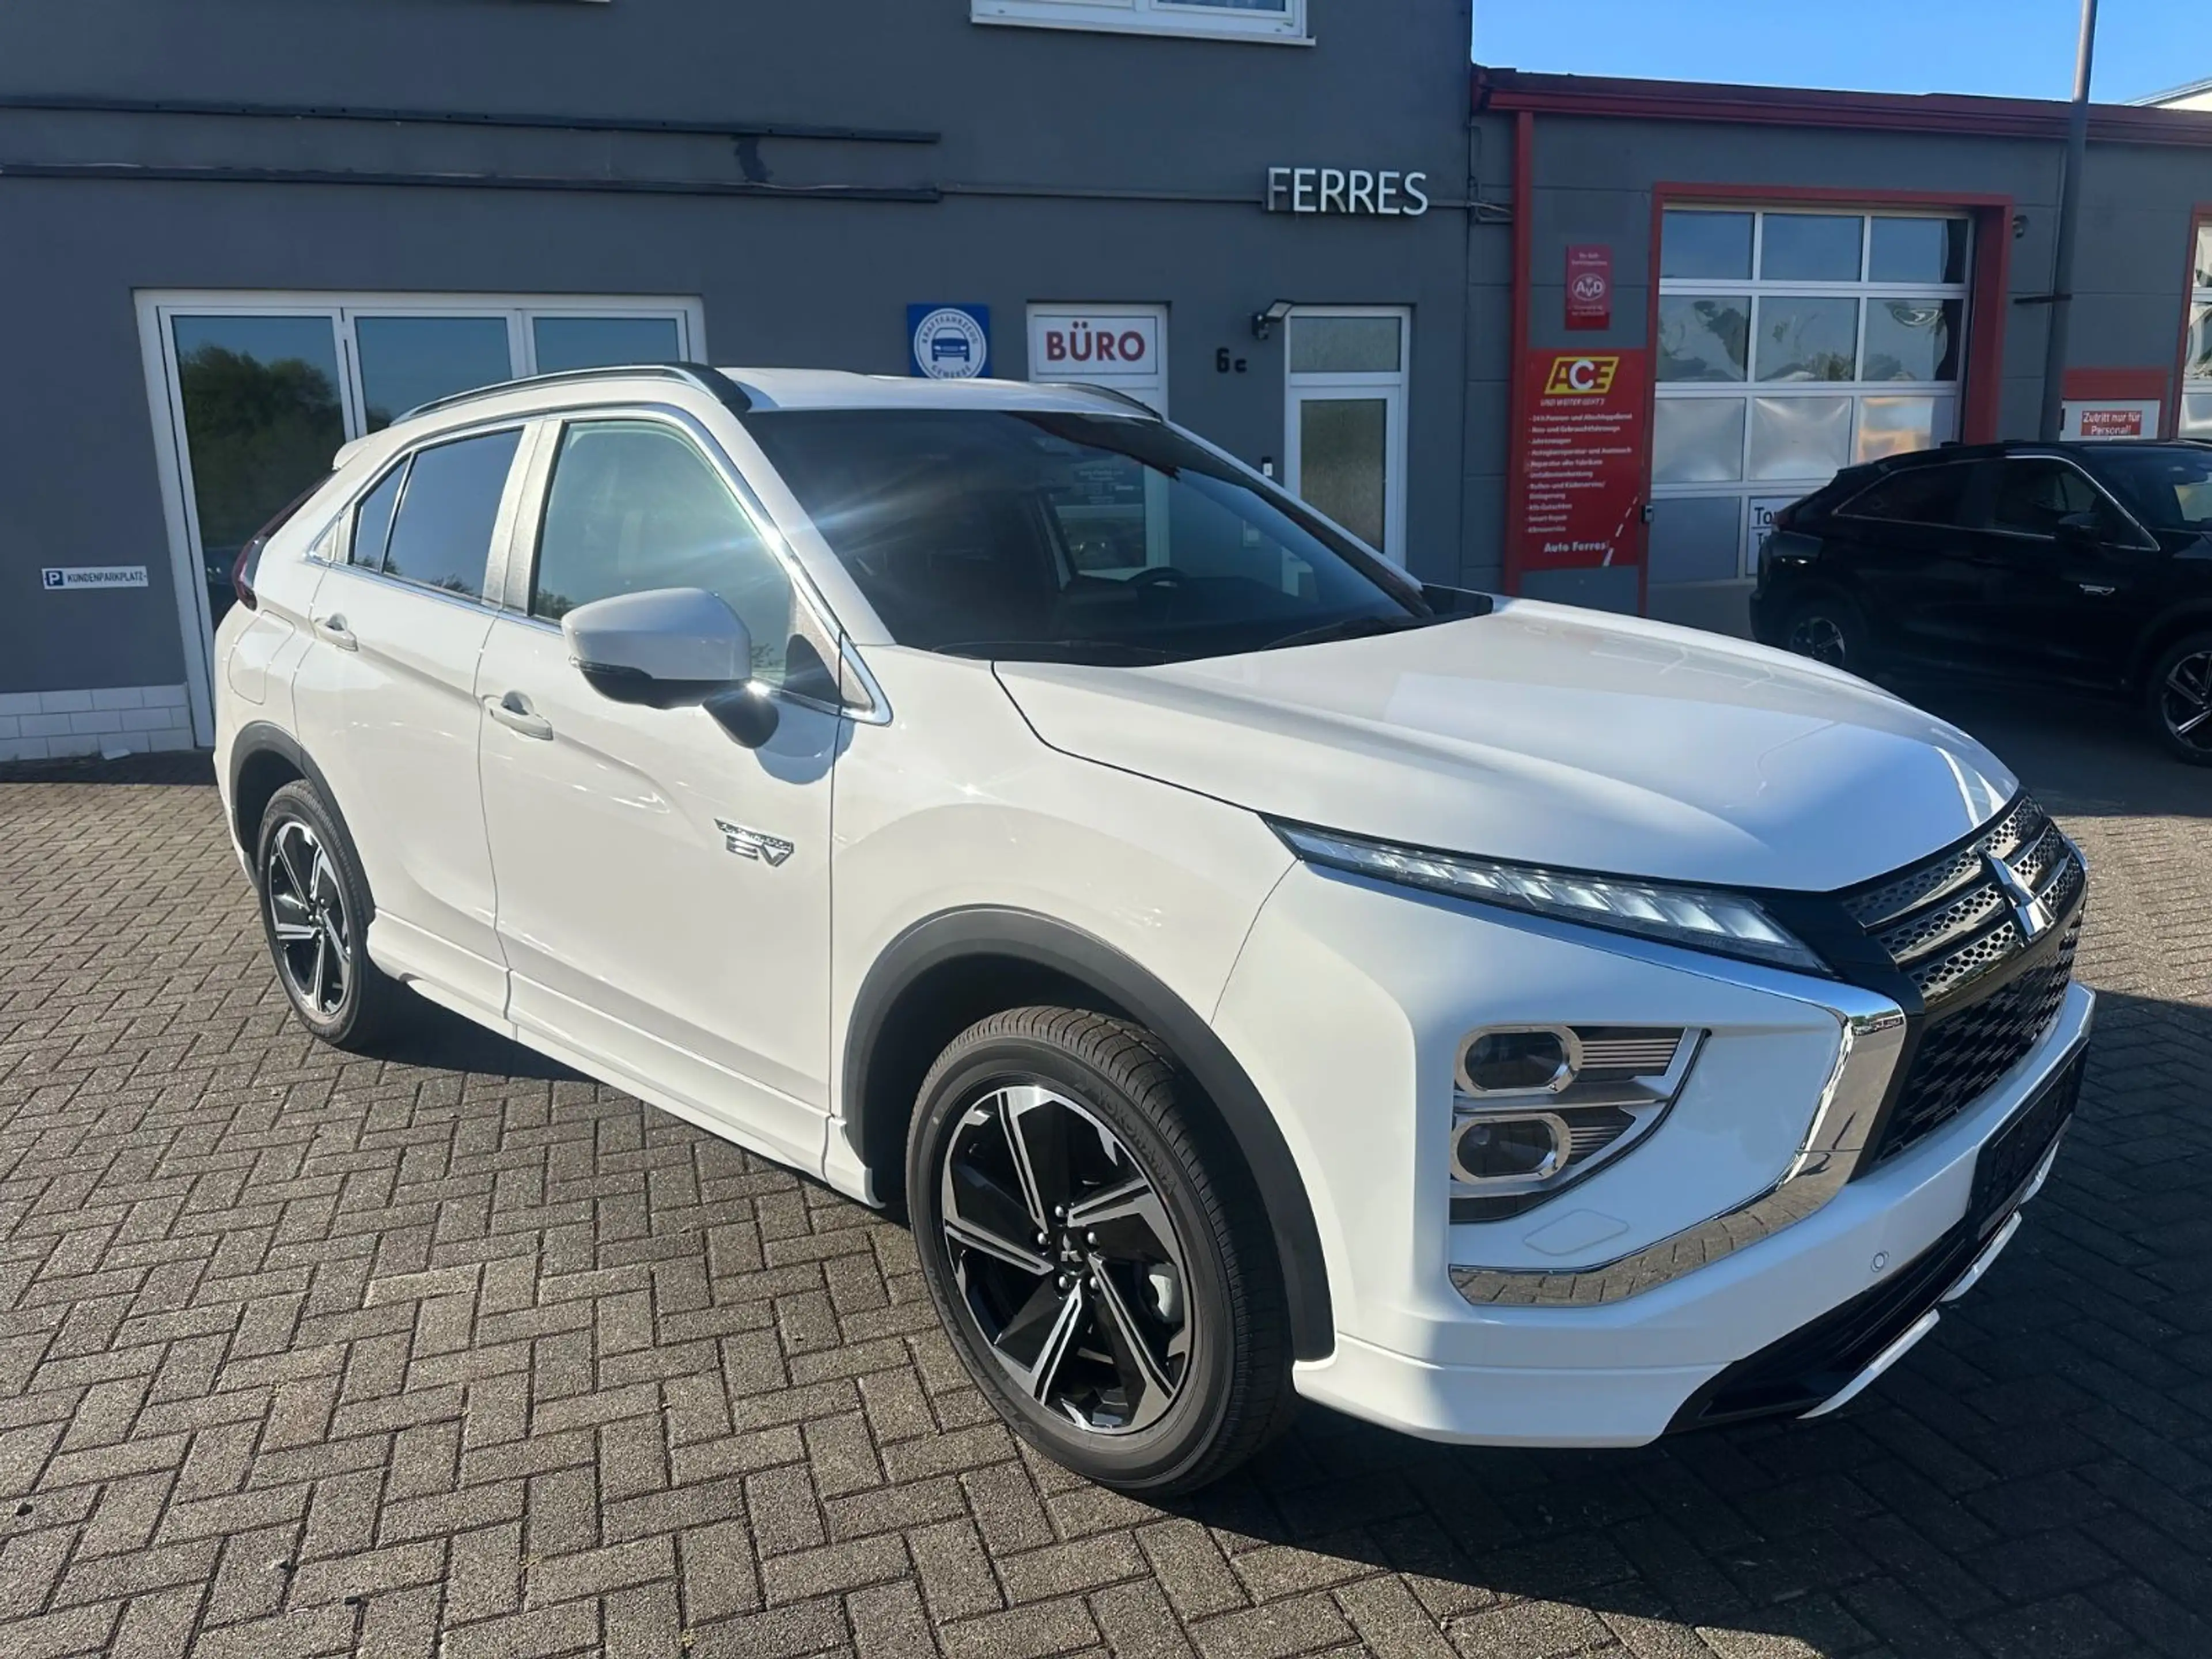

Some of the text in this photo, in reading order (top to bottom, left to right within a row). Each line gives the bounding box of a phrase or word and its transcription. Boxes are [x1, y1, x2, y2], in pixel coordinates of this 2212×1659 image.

[1268, 166, 1429, 215] FERRES
[1046, 321, 1146, 362] BÜRO
[2083, 412, 2141, 422] Zutritt nur für
[1544, 541, 1606, 553] Auto Ferres
[67, 571, 143, 582] KUNDENPARKPLATZ
